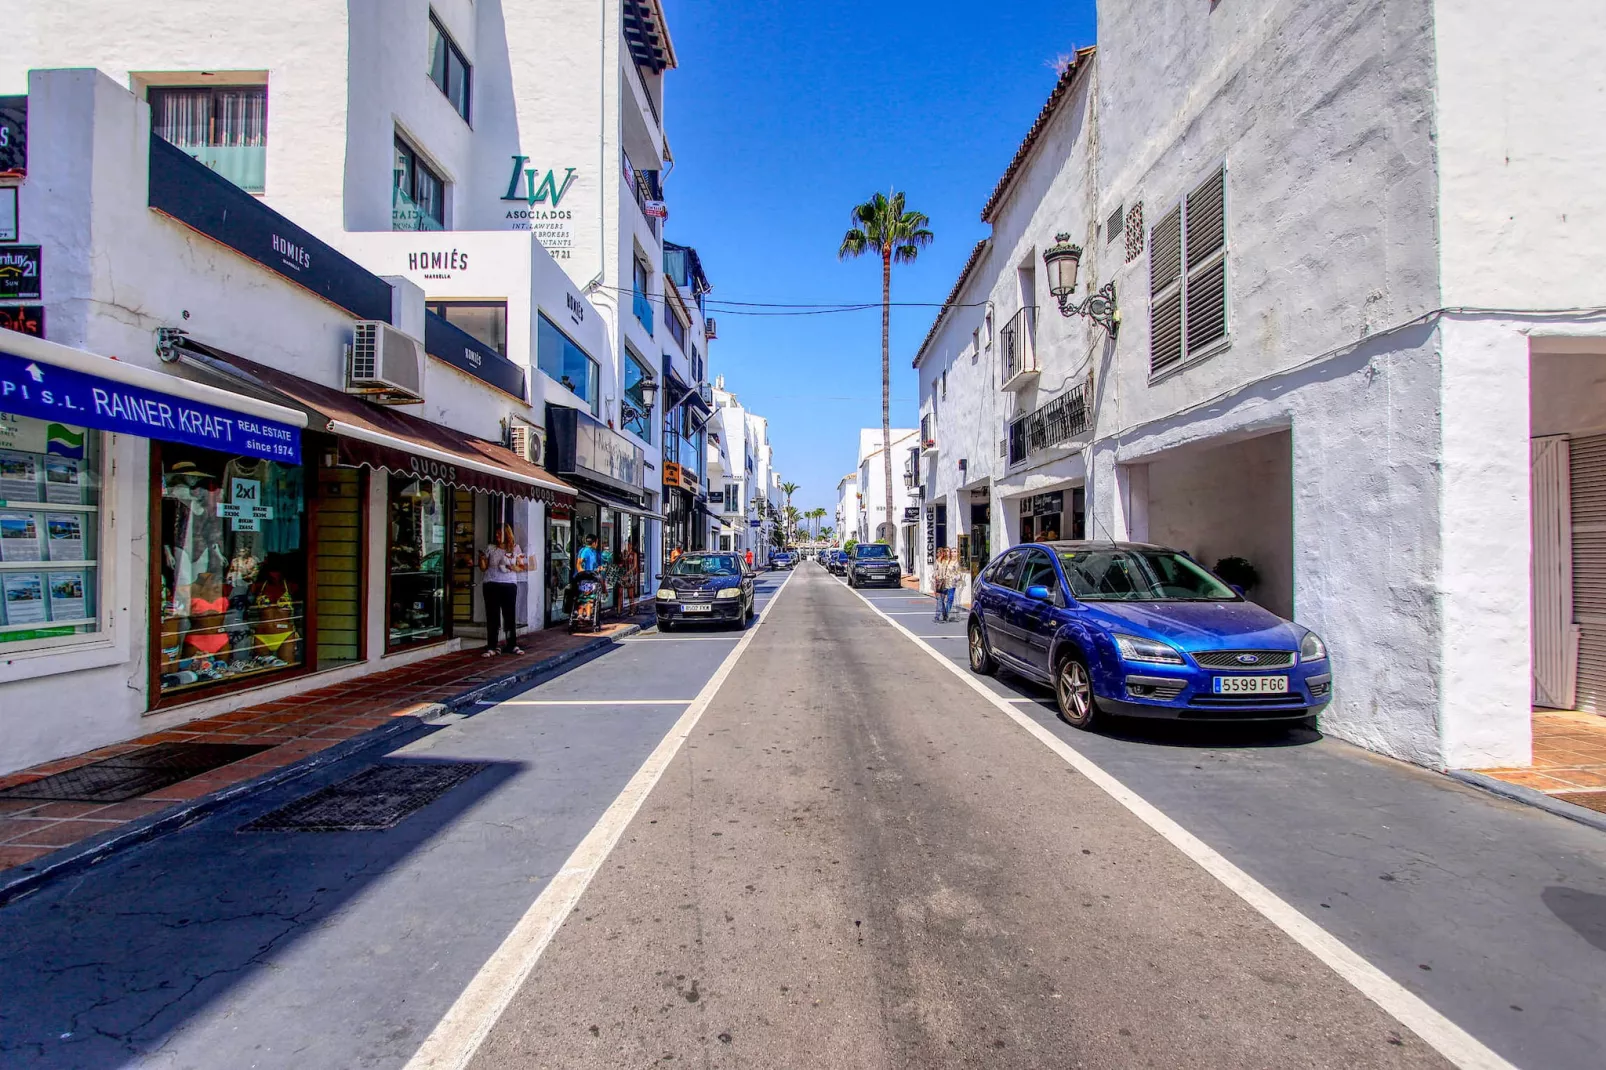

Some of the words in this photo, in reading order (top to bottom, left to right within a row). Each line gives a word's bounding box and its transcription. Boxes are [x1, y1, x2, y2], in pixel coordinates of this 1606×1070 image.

[506, 211, 572, 219] ASOCIADOS
[272, 234, 310, 268] HOMIÉS
[409, 249, 468, 270] HOMIÉS
[23, 261, 37, 277] 21
[92, 387, 175, 429] RAINER
[178, 407, 233, 442] KRAFT
[237, 420, 261, 435] REAL
[262, 426, 292, 441] ESTATE
[247, 440, 272, 453] since
[273, 444, 294, 457] 1974
[410, 456, 456, 480] QUOOS
[236, 483, 256, 499] 2x1
[530, 486, 555, 501] QUOOS
[926, 506, 934, 565] EXCHANGE
[1223, 678, 1257, 691] 5599
[1261, 678, 1284, 691] FGC
